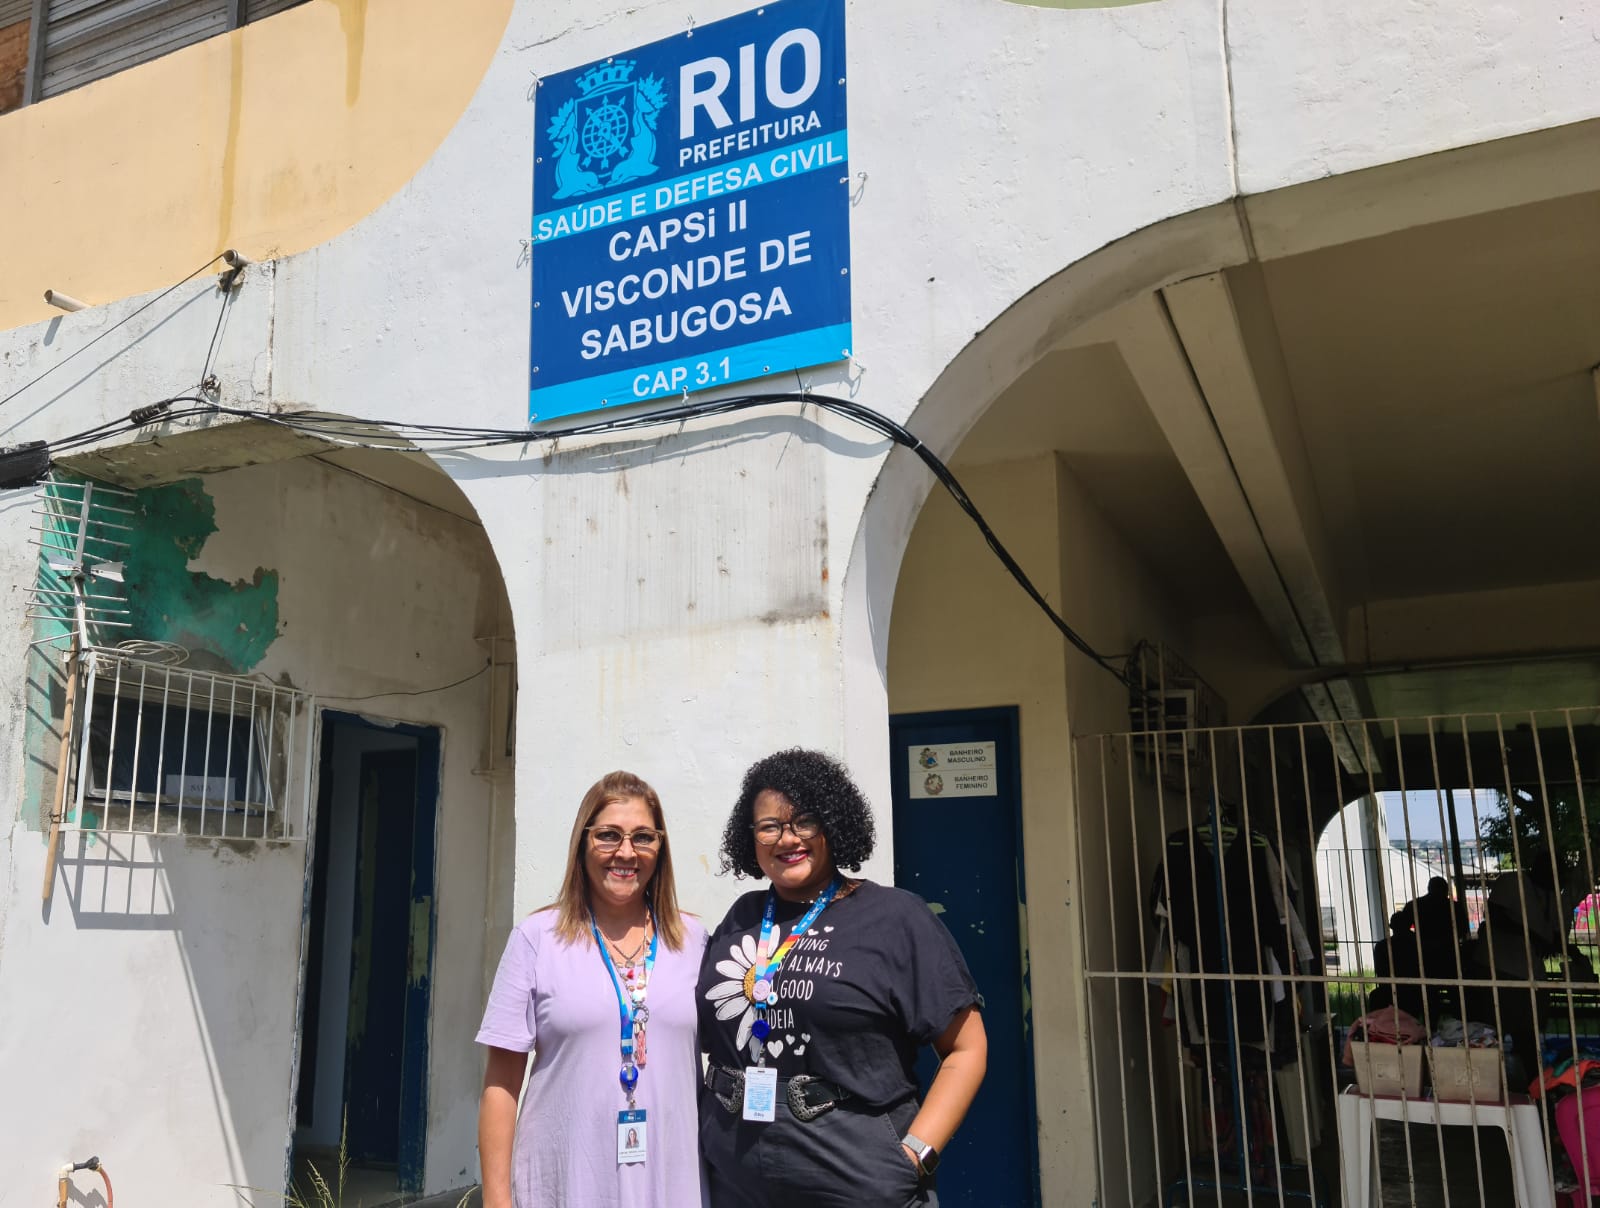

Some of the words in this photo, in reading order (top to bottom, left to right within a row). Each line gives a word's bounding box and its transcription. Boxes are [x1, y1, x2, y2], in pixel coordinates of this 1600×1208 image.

[679, 28, 821, 140] RIO
[679, 110, 821, 167] PREFEITURA
[537, 202, 622, 241] SAÚDE
[631, 193, 646, 217] E
[655, 163, 763, 210] DEFESA
[770, 141, 843, 178] CIVIL
[609, 208, 715, 261] CAPSi
[728, 199, 747, 233] II
[561, 247, 747, 318] VISCONDE
[760, 230, 812, 273] DE
[580, 286, 792, 360] SABUGOSA
[633, 366, 688, 397] CAP
[696, 357, 731, 385] 3.1
[787, 954, 843, 978] ALWAYS
[793, 937, 829, 951] VING
[767, 1007, 795, 1030] IDEIA
[780, 979, 814, 1001] GOOD
